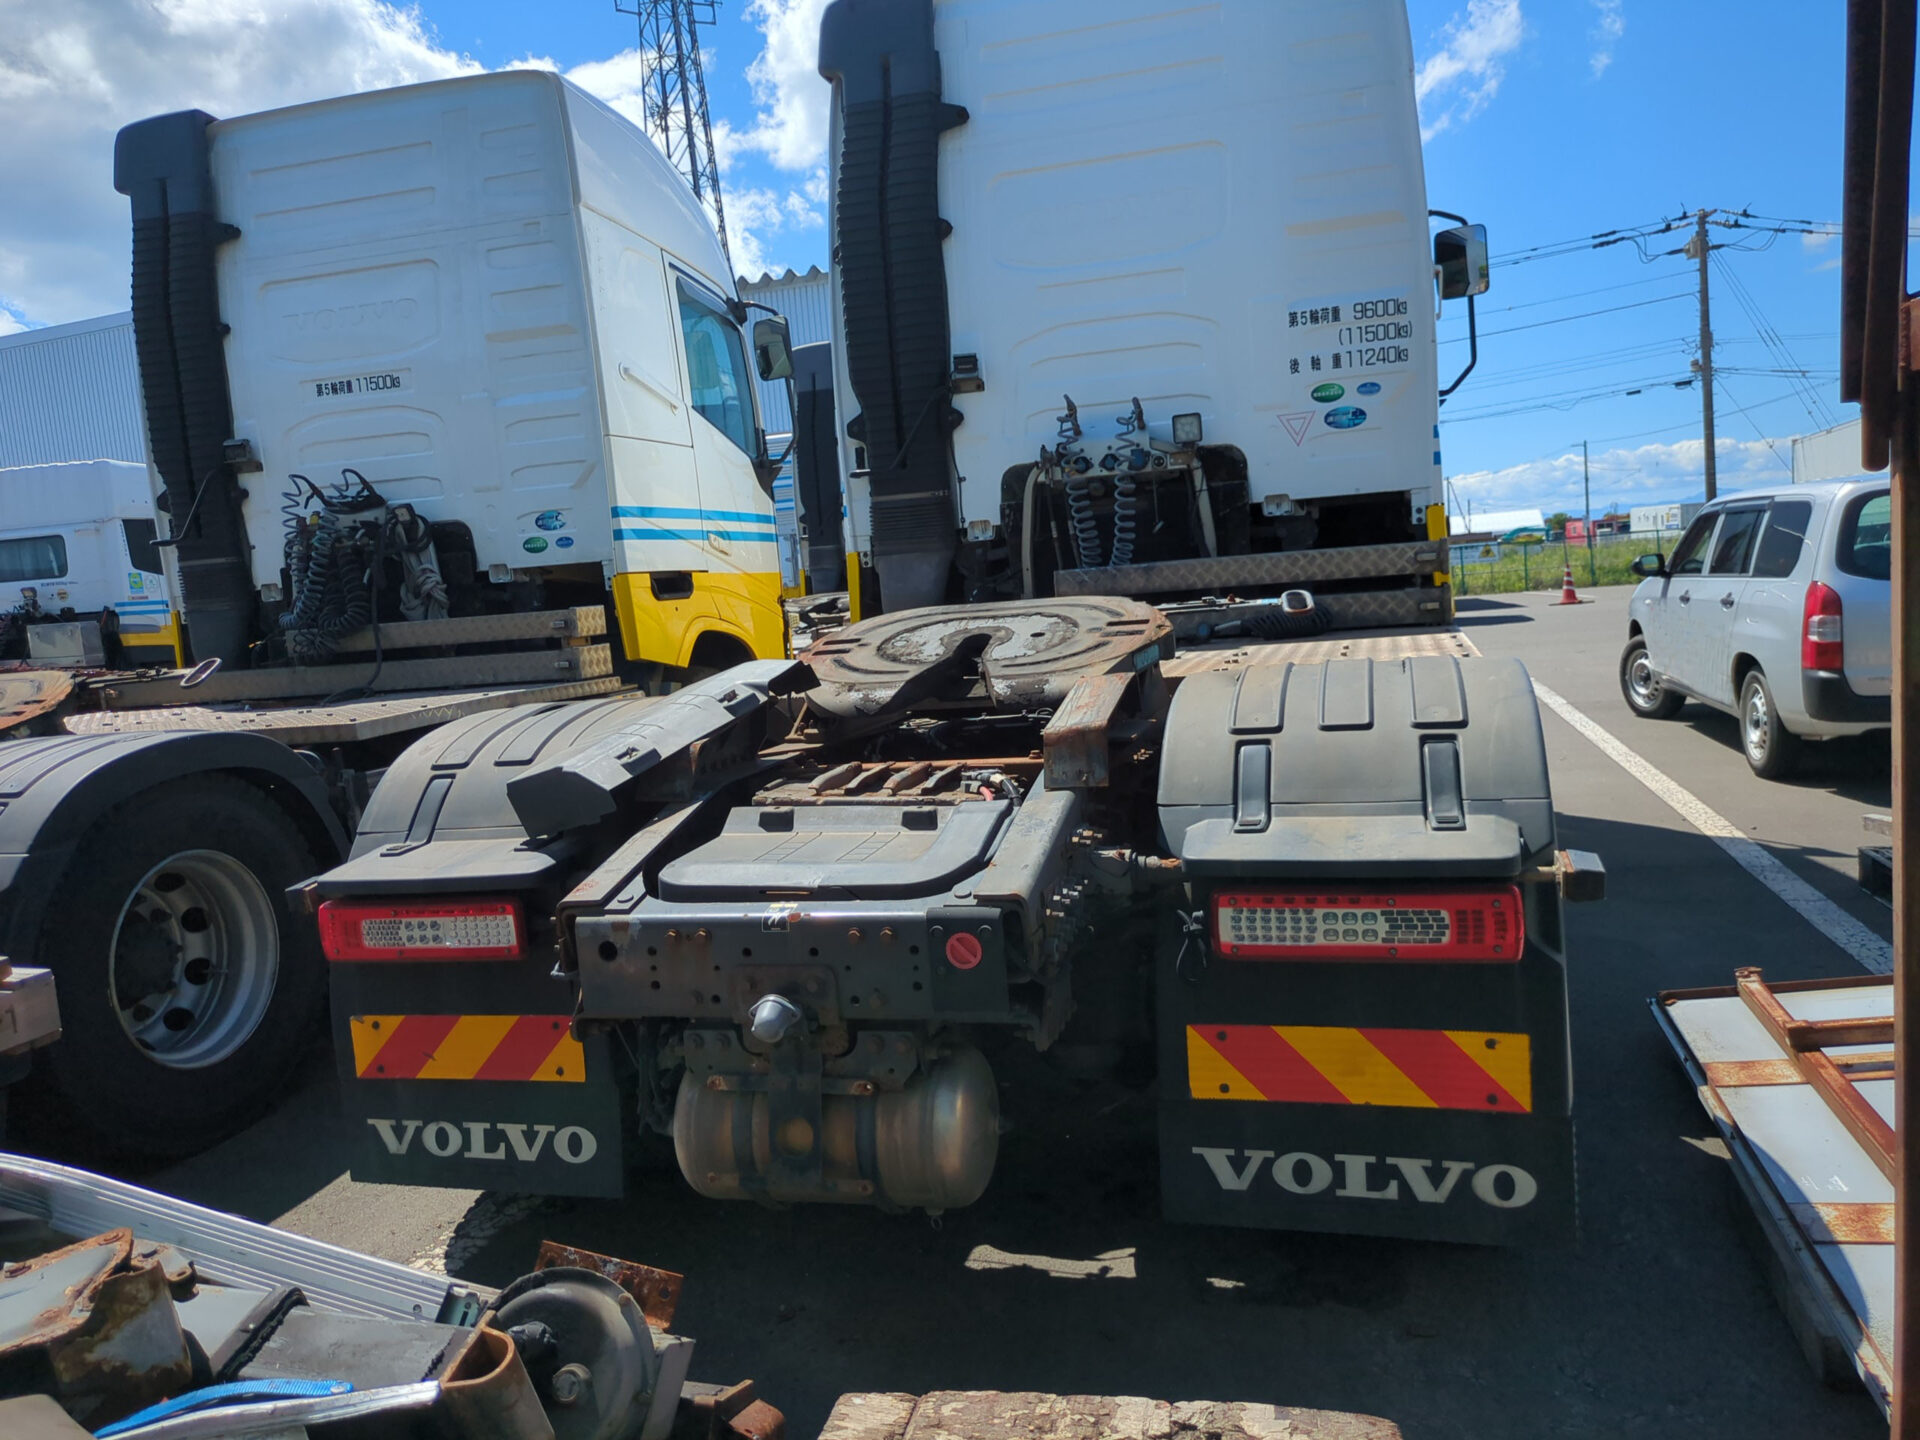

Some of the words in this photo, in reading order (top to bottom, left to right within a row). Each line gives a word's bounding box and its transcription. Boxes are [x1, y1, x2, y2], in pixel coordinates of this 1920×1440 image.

[1353, 298, 1408, 320] 9600kg
[1338, 320, 1413, 346] (11500kg)
[1345, 345, 1409, 369] 11240kg
[366, 1118, 598, 1164] VOLVO
[1192, 1146, 1538, 1209] VOLVO
